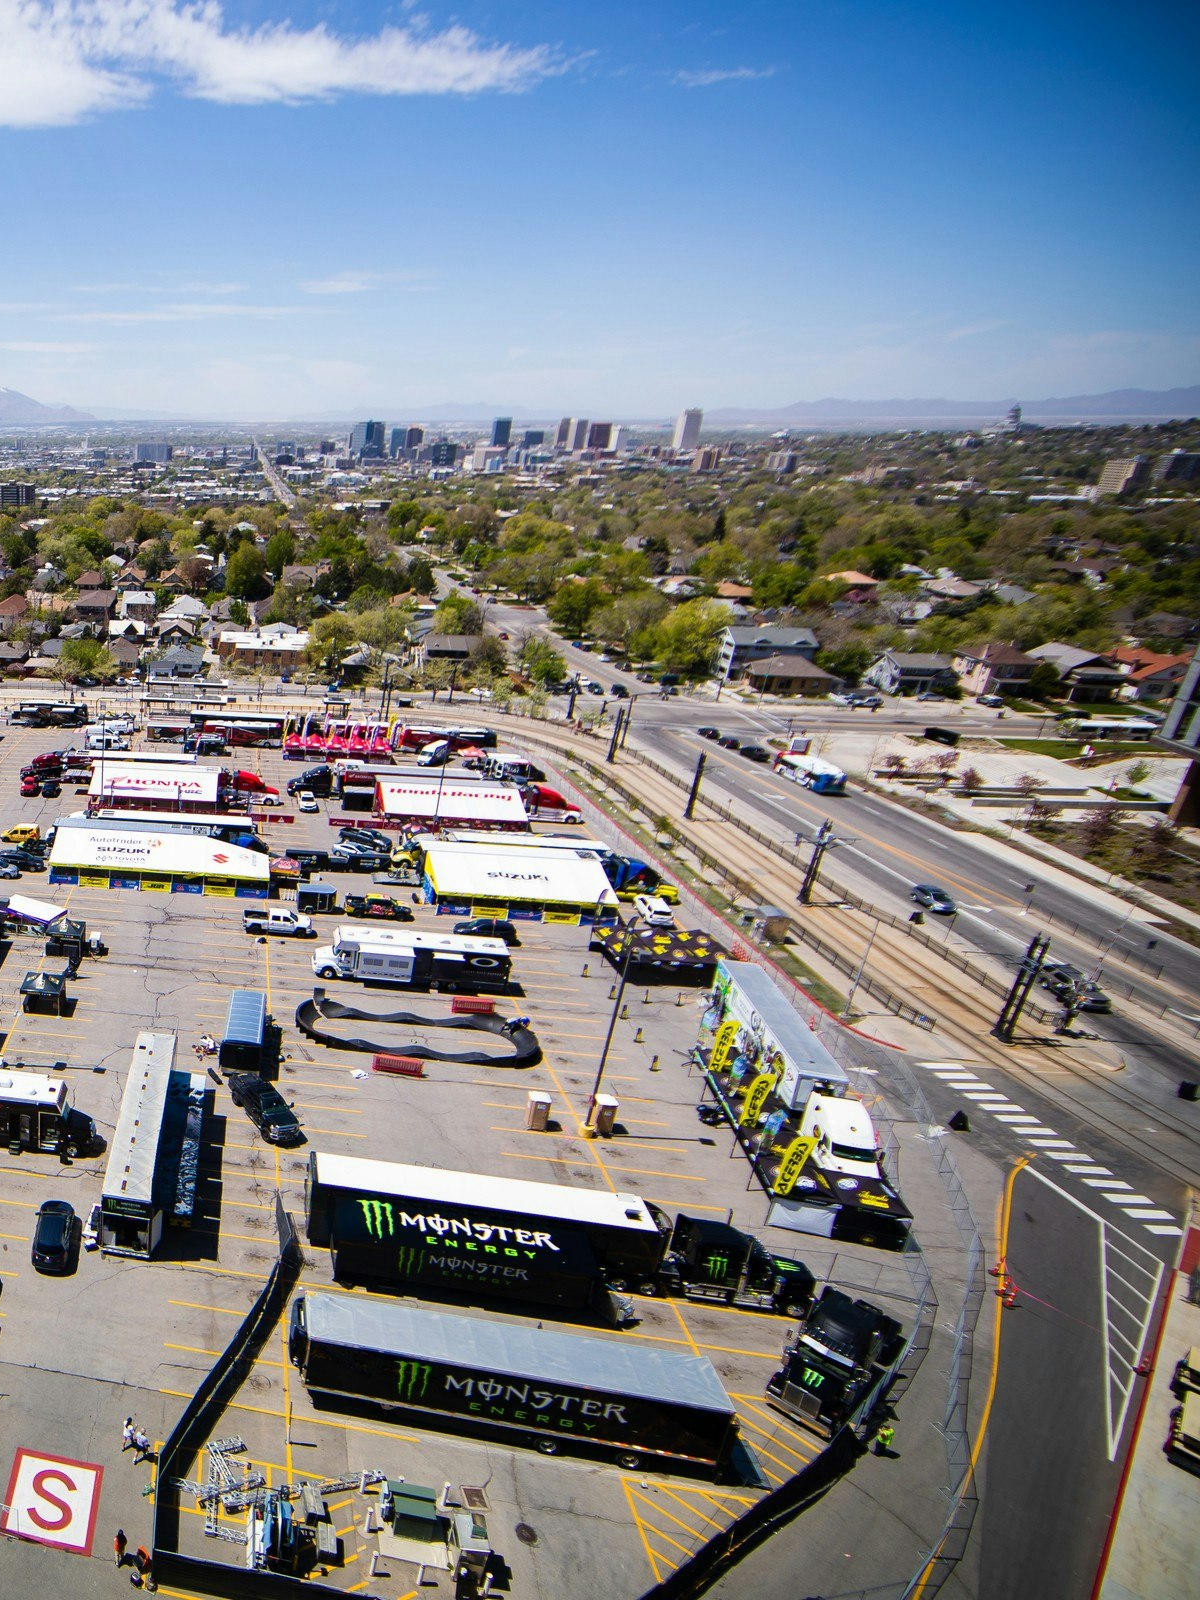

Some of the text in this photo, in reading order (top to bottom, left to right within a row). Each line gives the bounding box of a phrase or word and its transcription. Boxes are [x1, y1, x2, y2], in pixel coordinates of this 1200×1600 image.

[126, 779, 202, 788] HONDA
[89, 836, 142, 845] Autotrader
[97, 846, 151, 854] SUZUKI
[487, 871, 549, 882] SUZUKI
[778, 1142, 809, 1194] ACERBIS
[399, 1211, 560, 1251] MONSTER
[425, 1236, 537, 1260] ENERGY
[428, 1254, 529, 1281] MONSTER
[442, 1270, 512, 1286] ENERGY
[443, 1374, 629, 1424] MONSTER
[468, 1401, 597, 1432] ENERGY
[26, 1468, 78, 1531] S
